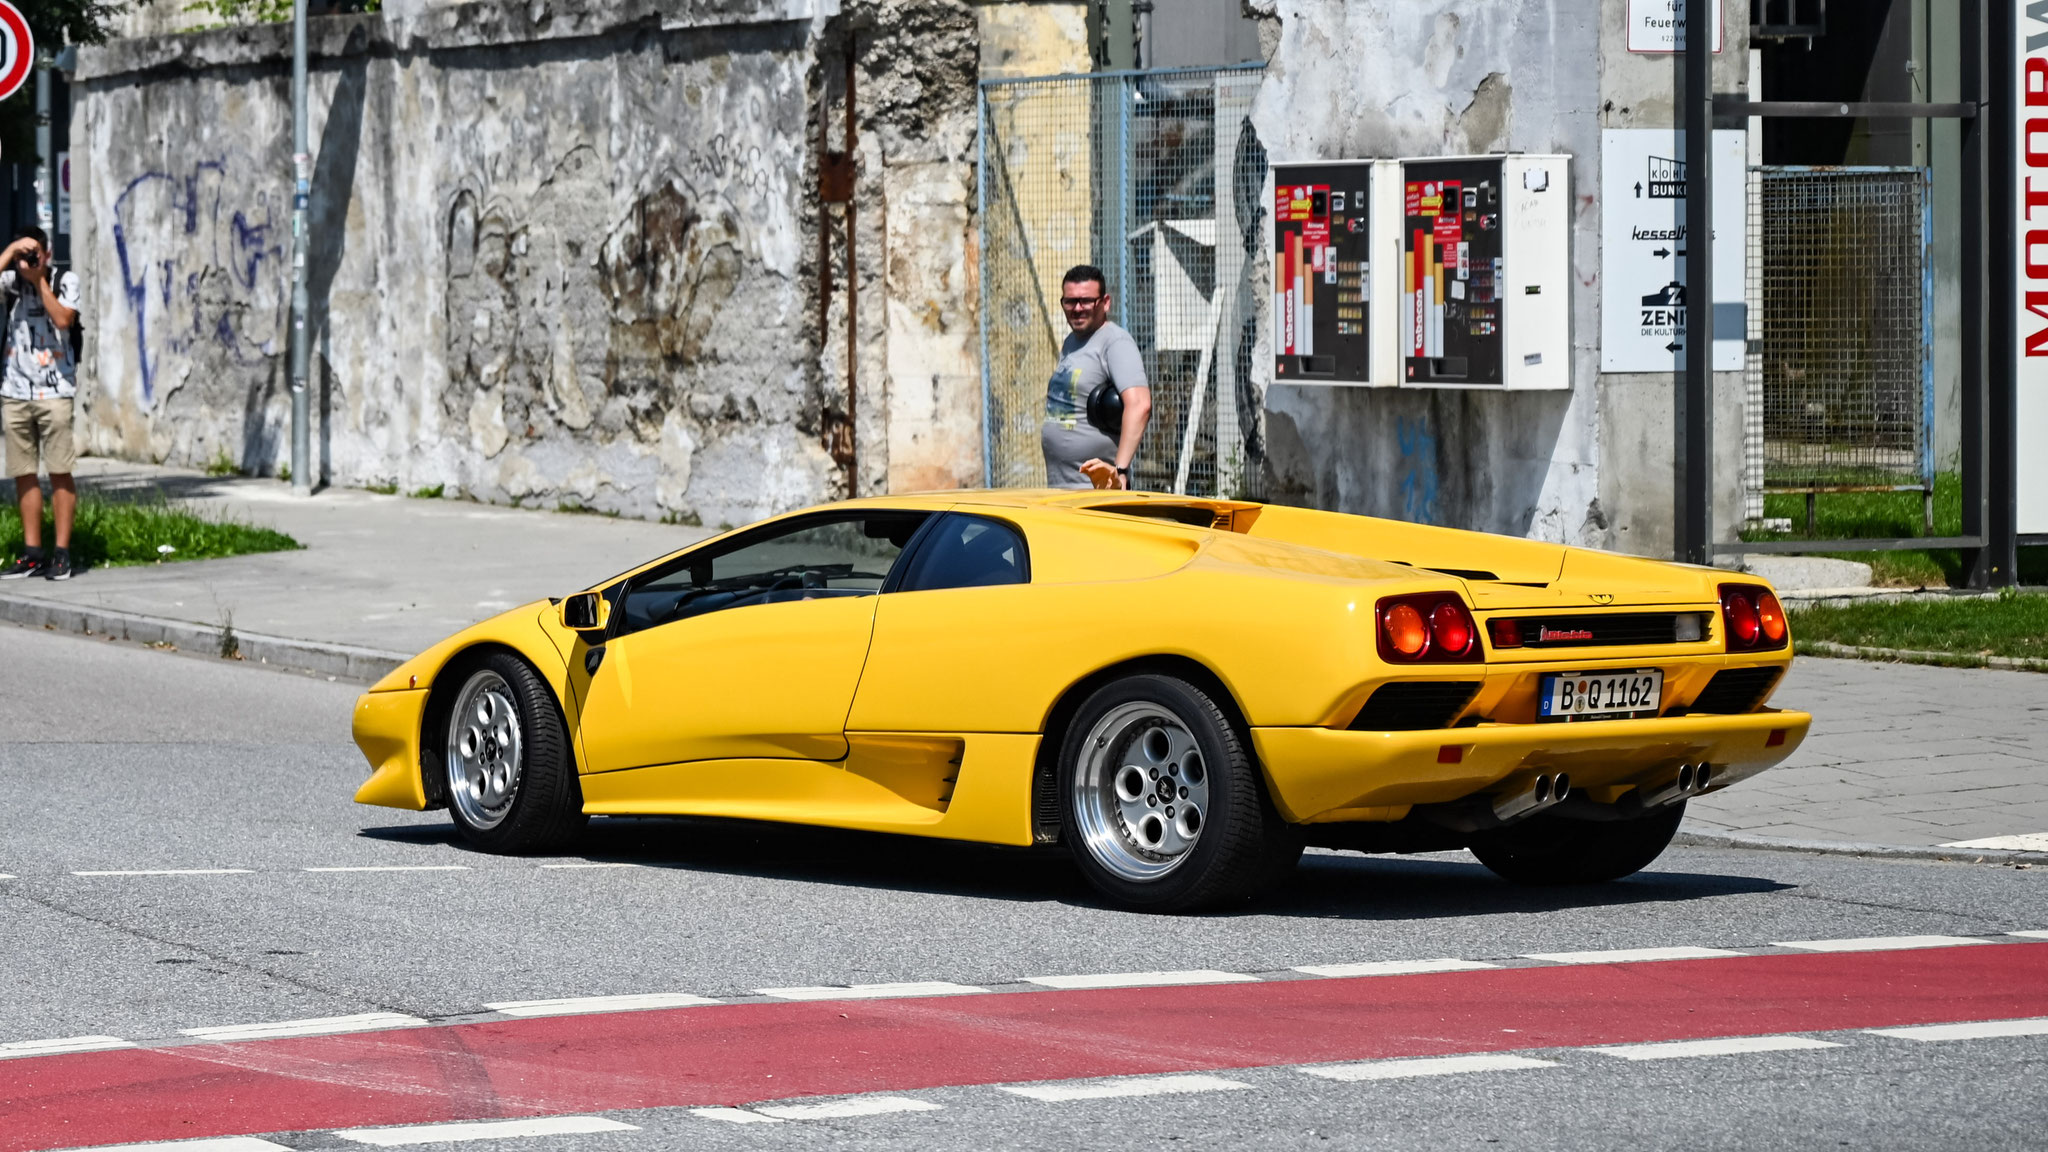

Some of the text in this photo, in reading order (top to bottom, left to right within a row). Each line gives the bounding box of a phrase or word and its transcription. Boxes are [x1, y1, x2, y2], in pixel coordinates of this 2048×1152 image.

[1667, 0, 1684, 12] für
[1645, 16, 1687, 28] Feuerw
[1286, 289, 1294, 347] tabacon
[1415, 289, 1423, 349] tabacon
[1641, 310, 1687, 326] ZENI
[1641, 327, 1687, 336] DIE KULTUR
[1543, 676, 1653, 710] D B Q 1162
